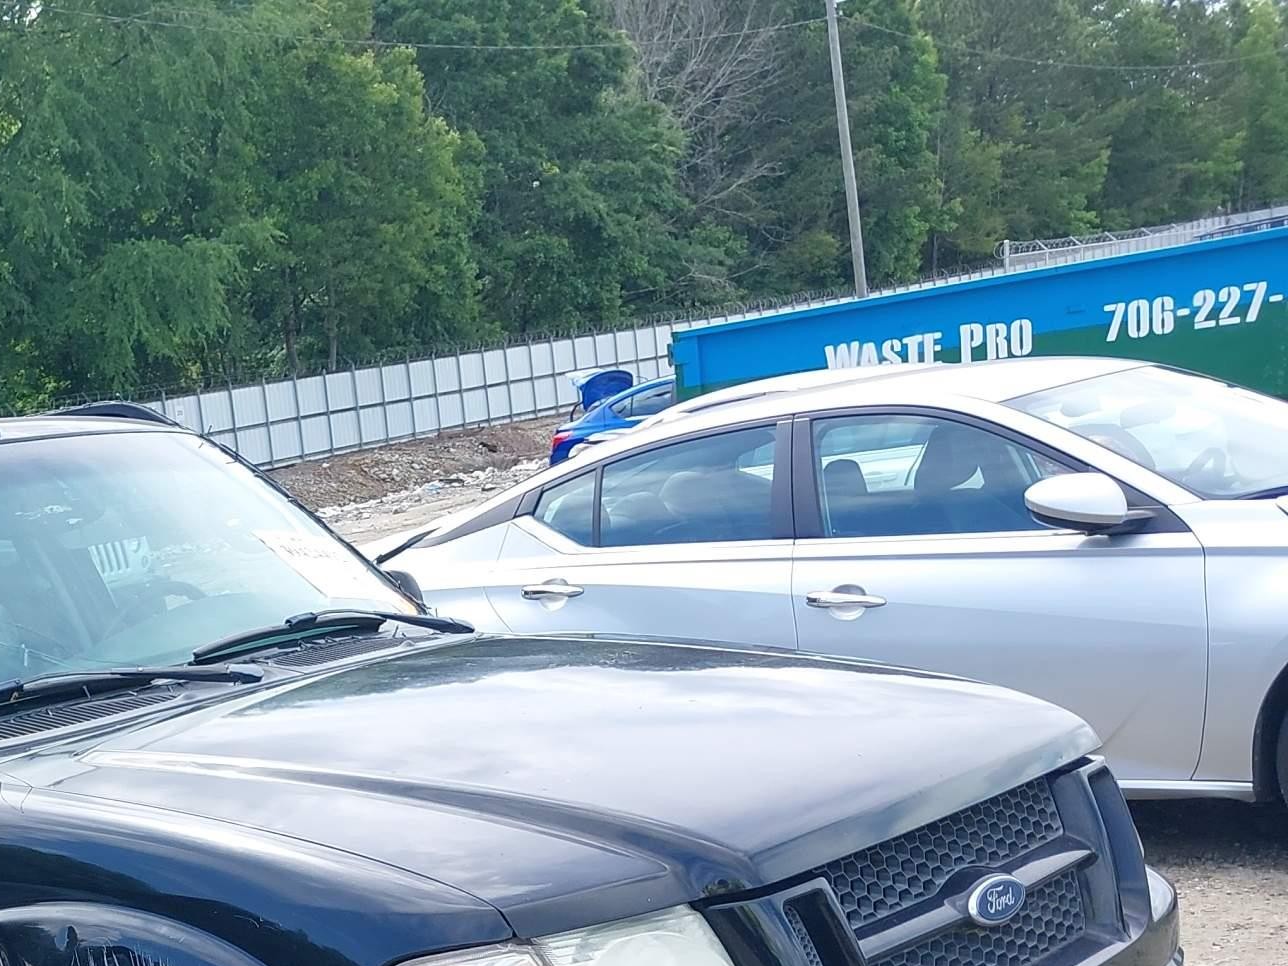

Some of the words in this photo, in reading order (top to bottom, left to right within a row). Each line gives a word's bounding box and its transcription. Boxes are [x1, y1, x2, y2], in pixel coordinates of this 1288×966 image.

[1103, 281, 1284, 342] 706-227-
[824, 332, 943, 370] WASTE
[959, 318, 1033, 364] PRO
[987, 885, 1015, 914] Ford
